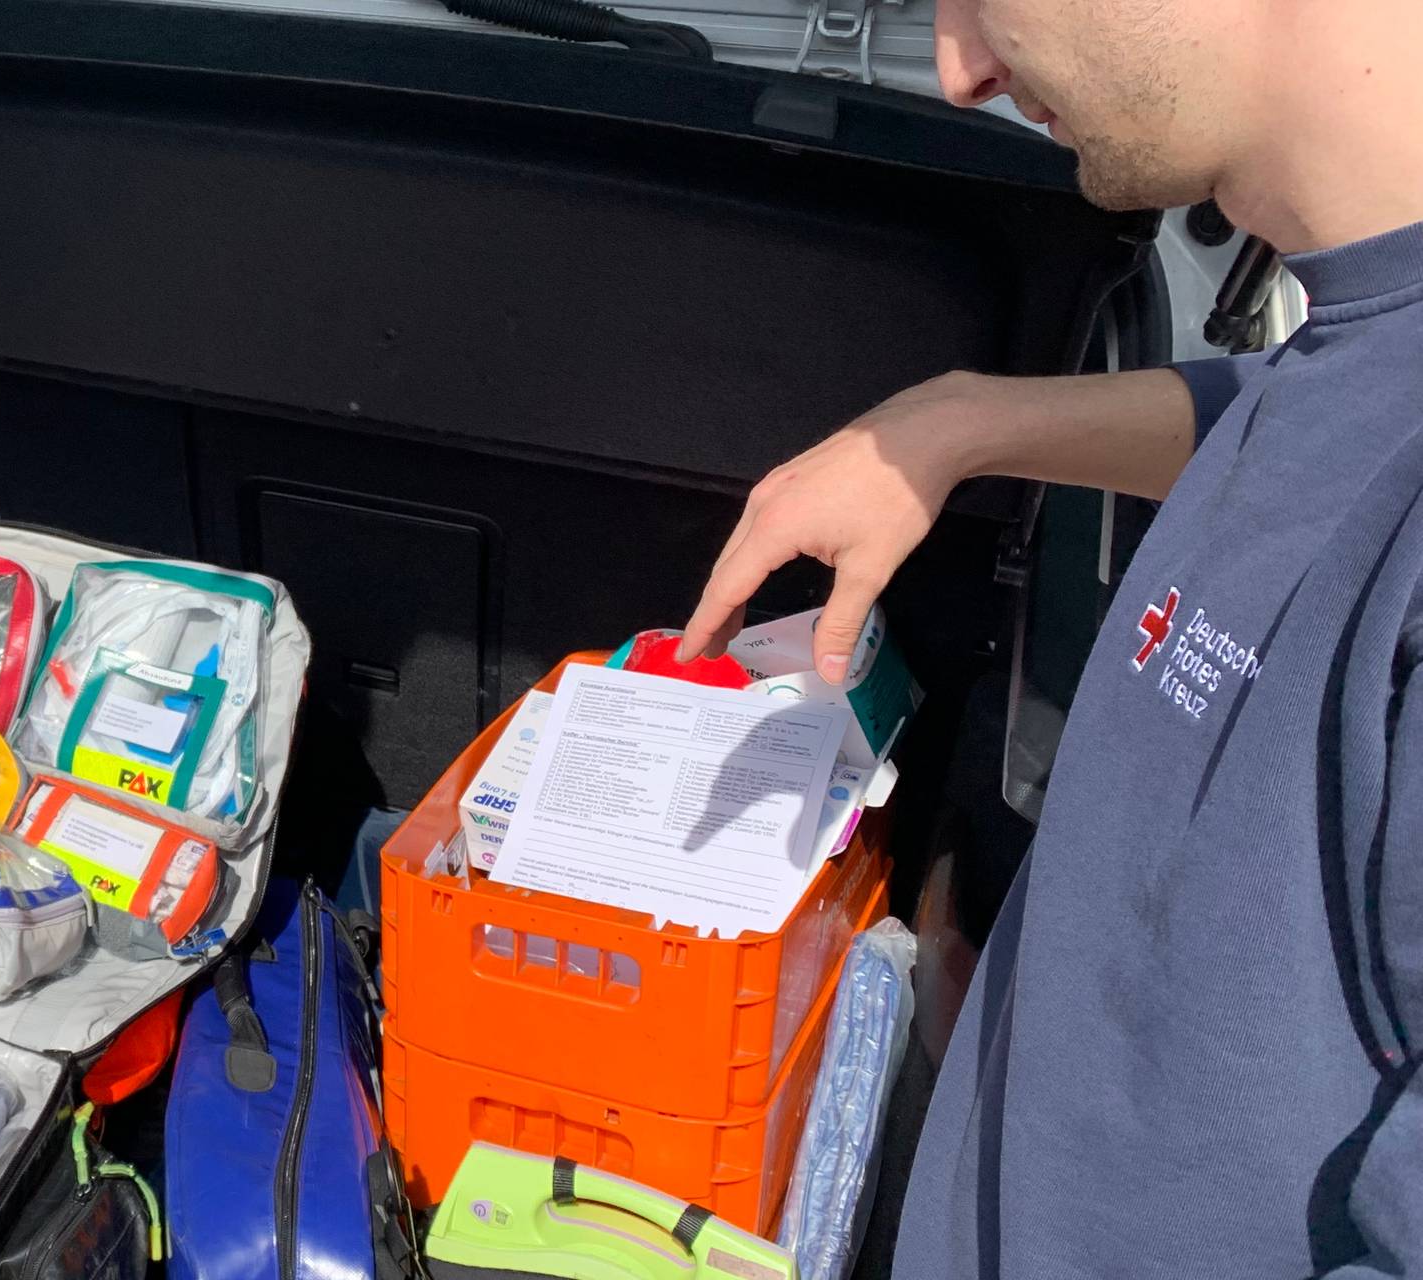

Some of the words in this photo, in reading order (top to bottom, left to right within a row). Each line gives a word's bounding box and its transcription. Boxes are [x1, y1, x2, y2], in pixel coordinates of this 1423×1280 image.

[1186, 608, 1262, 680] Deutsch
[1170, 635, 1222, 692] Rotes
[1159, 664, 1208, 718] Kreuz
[118, 768, 164, 799] PAX
[479, 781, 507, 797] Long
[473, 793, 517, 813] GRIP
[90, 875, 121, 896] PAX
